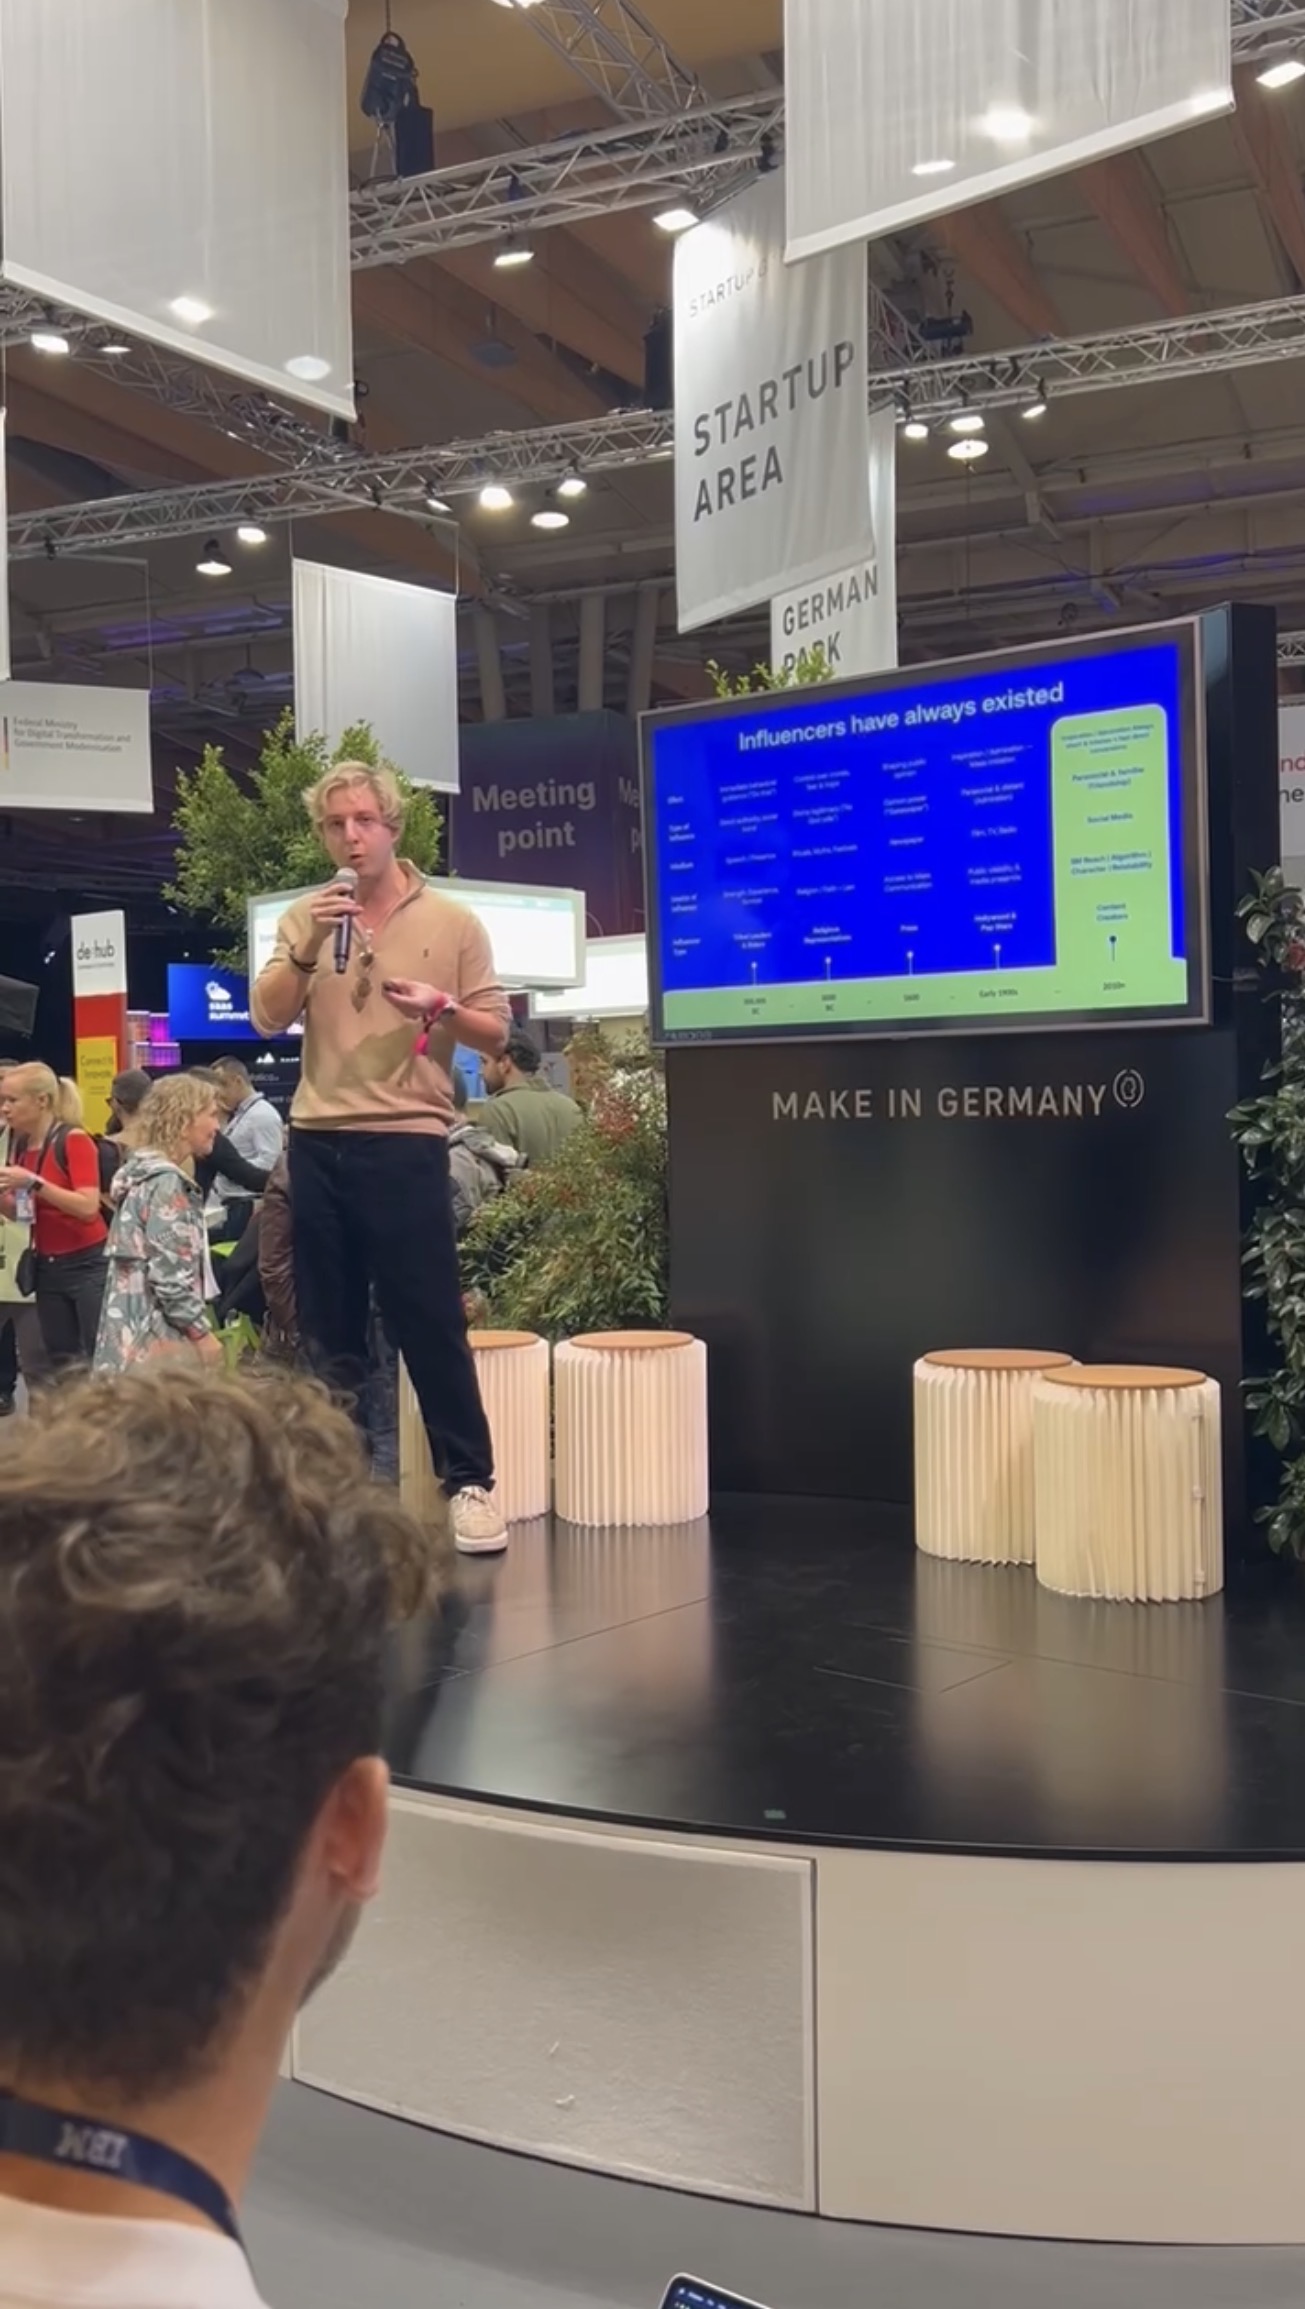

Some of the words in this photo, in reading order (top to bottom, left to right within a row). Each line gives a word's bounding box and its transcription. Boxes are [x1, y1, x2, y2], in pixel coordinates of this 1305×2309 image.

[689, 266, 754, 318] STARTUP
[694, 340, 855, 457] STARTUP
[694, 445, 783, 522] AREA
[782, 564, 879, 636] GERMAN
[738, 718, 846, 751] Influencers
[851, 709, 899, 735] have
[904, 698, 976, 725] always
[982, 681, 1064, 713] existed
[472, 778, 597, 812] Meeting
[498, 821, 576, 858] point
[772, 1089, 873, 1120] MAKE
[889, 1088, 922, 1117] IN
[937, 1084, 1107, 1118] GERMANY
[54, 2120, 130, 2170] IBM
